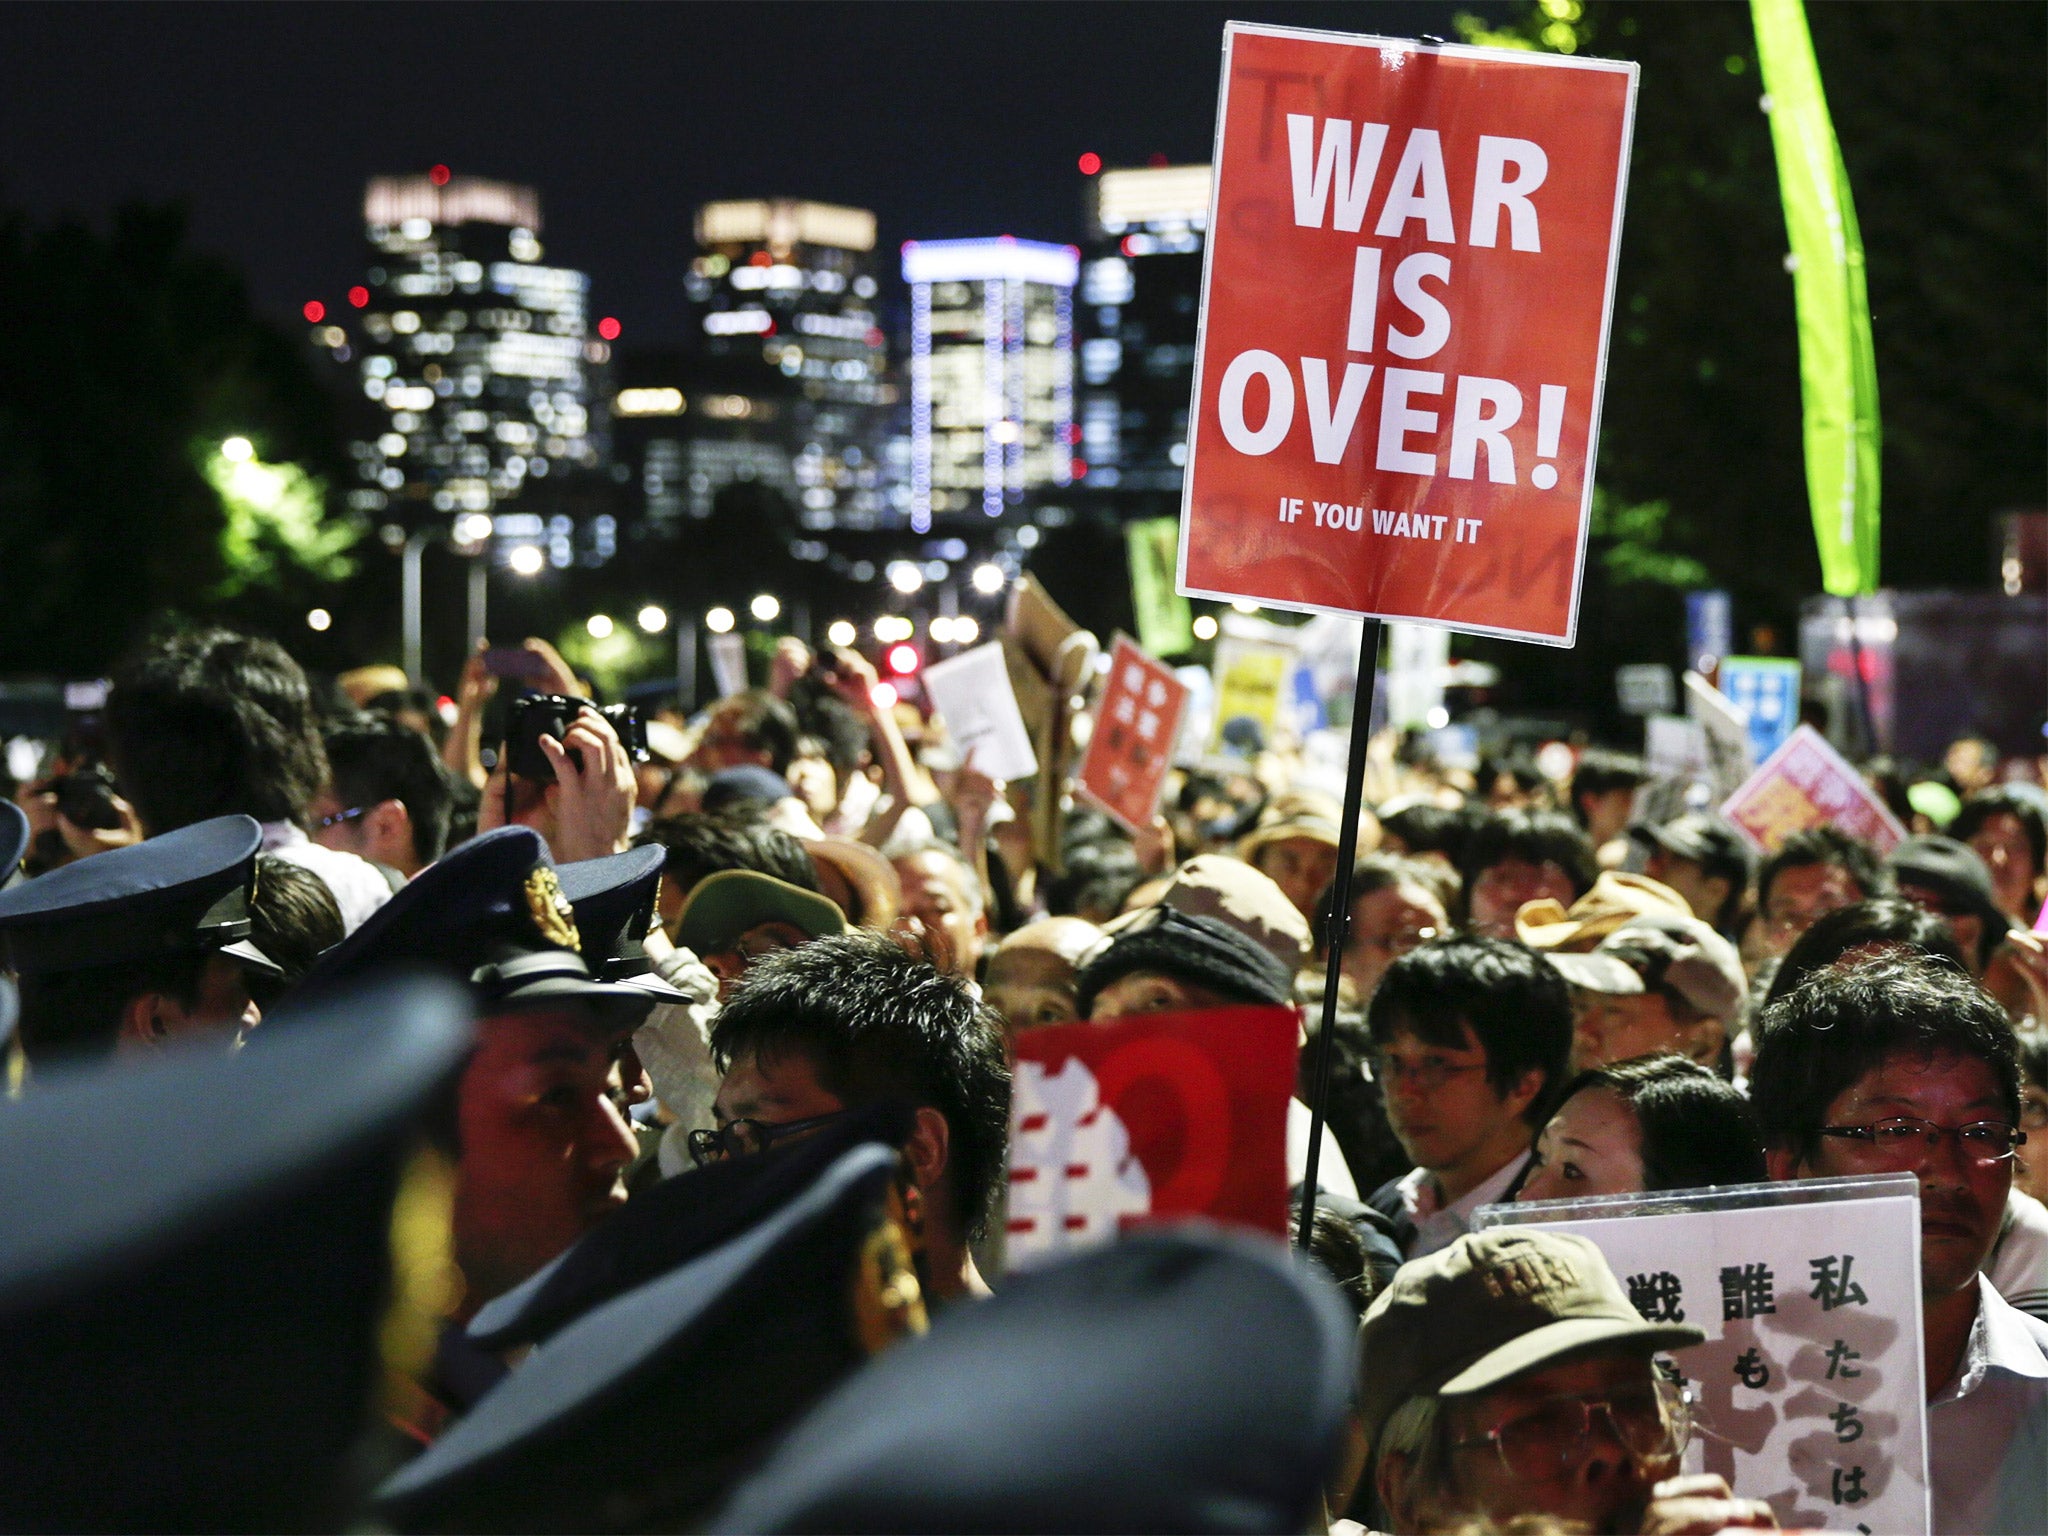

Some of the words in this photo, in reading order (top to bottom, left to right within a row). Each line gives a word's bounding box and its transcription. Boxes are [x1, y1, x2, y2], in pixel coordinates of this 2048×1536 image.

[1287, 113, 1549, 253] WAR
[1346, 247, 1452, 360] IS
[1218, 350, 1568, 491] OVER!
[1278, 497, 1304, 523] IF
[1312, 501, 1364, 532] YOU
[1373, 509, 1449, 541] WANT
[1455, 517, 1483, 544] IT
[1719, 1262, 1776, 1390] 誰も
